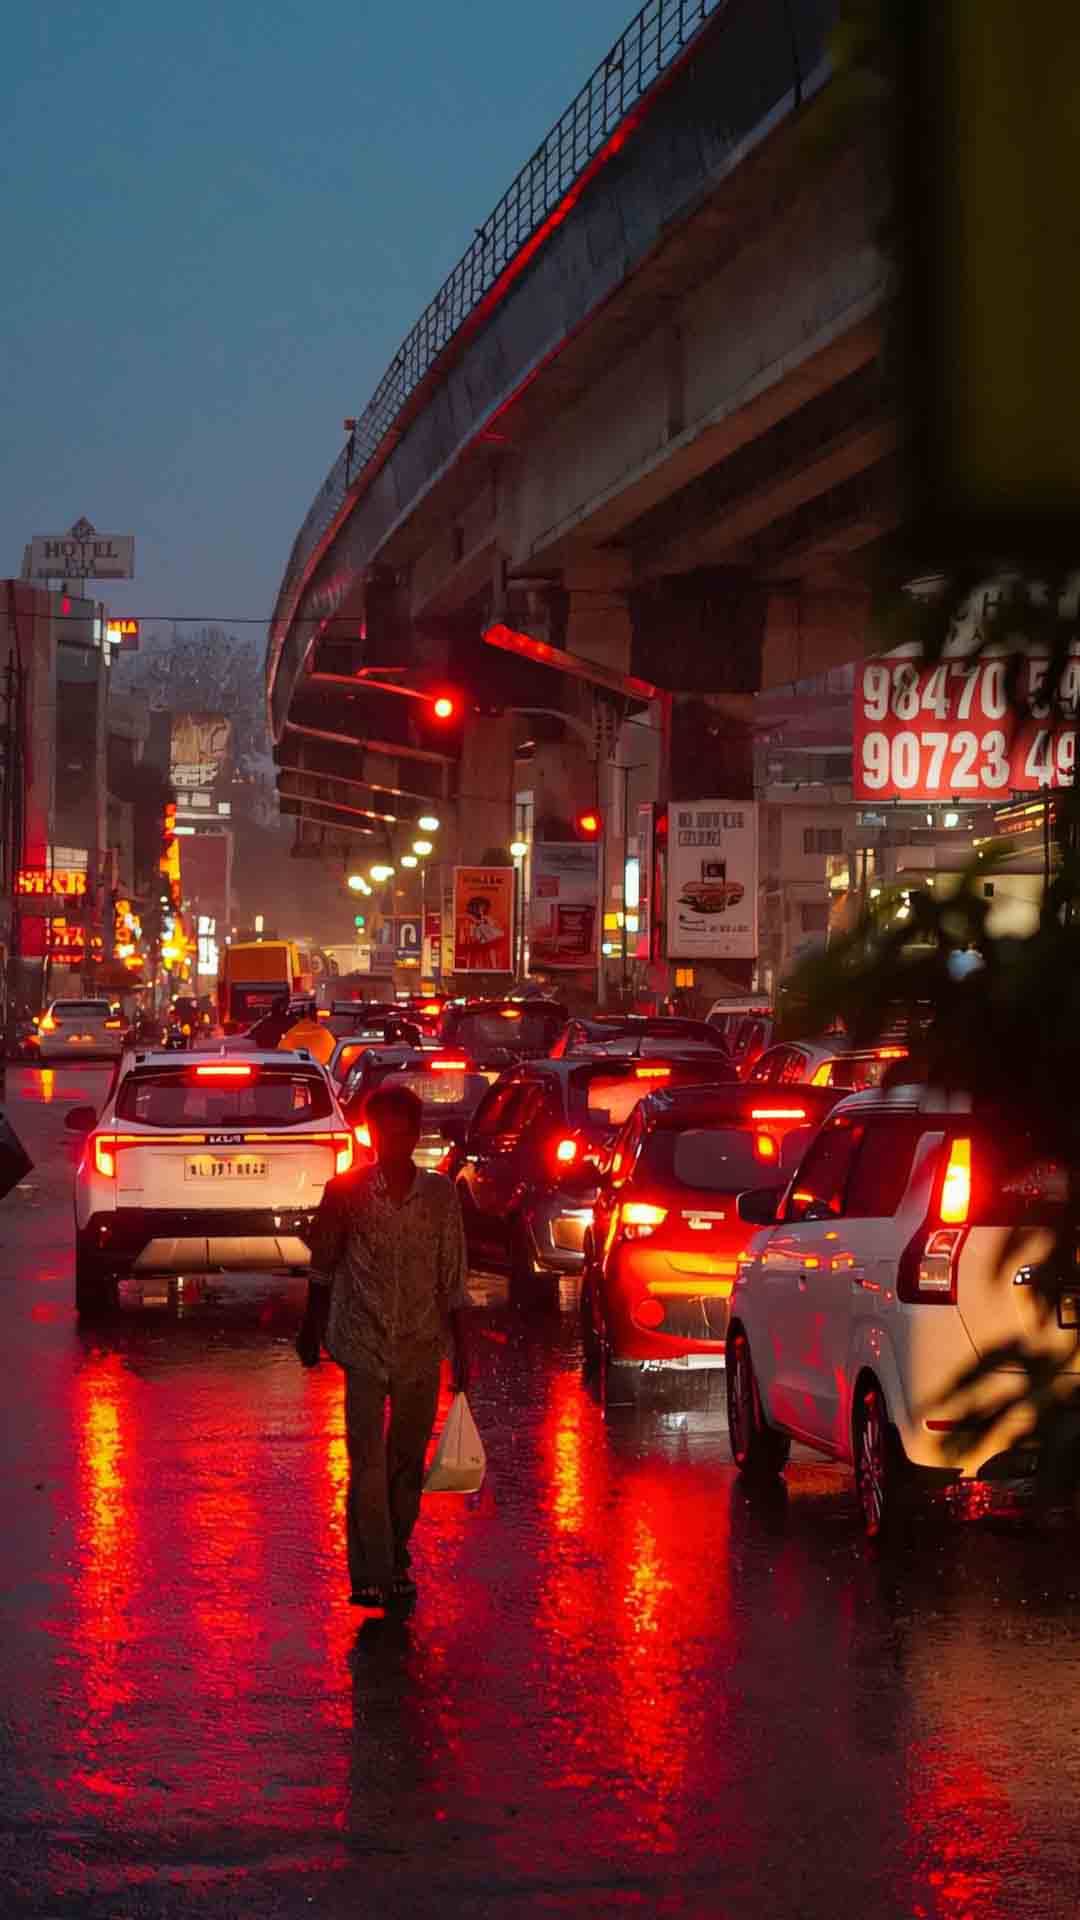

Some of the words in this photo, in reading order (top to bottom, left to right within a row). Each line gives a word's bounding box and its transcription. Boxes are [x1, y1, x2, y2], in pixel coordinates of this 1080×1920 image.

[43, 541, 119, 558] HOTEL
[863, 661, 1006, 720] 98470
[862, 730, 1009, 790] 90723
